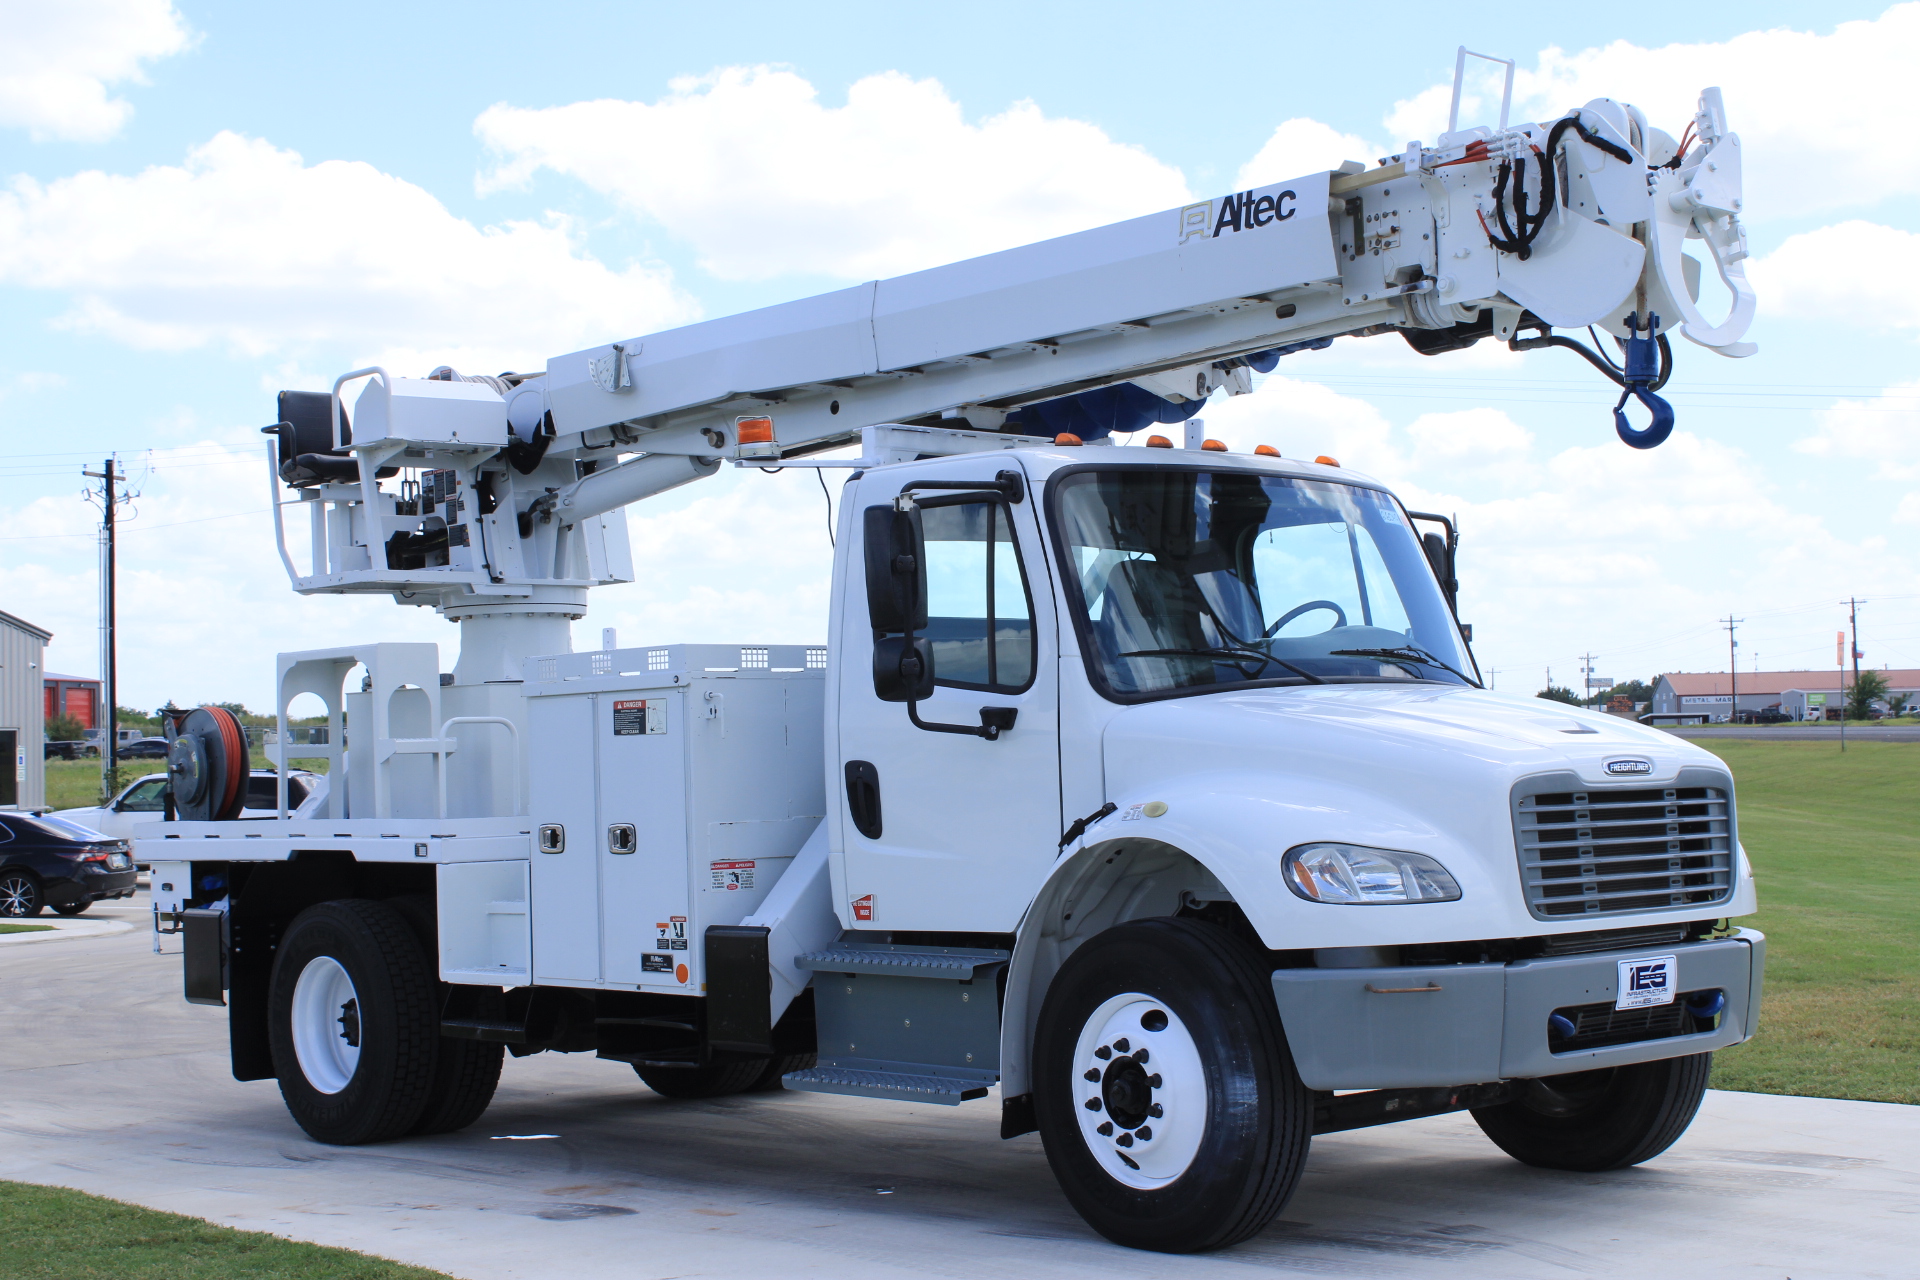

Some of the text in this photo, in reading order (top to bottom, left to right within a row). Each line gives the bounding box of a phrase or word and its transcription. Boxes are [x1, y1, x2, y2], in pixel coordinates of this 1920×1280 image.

[1212, 190, 1297, 238] Altec
[1610, 762, 1650, 771] FREIGHTLINER
[1630, 963, 1666, 990] IES
